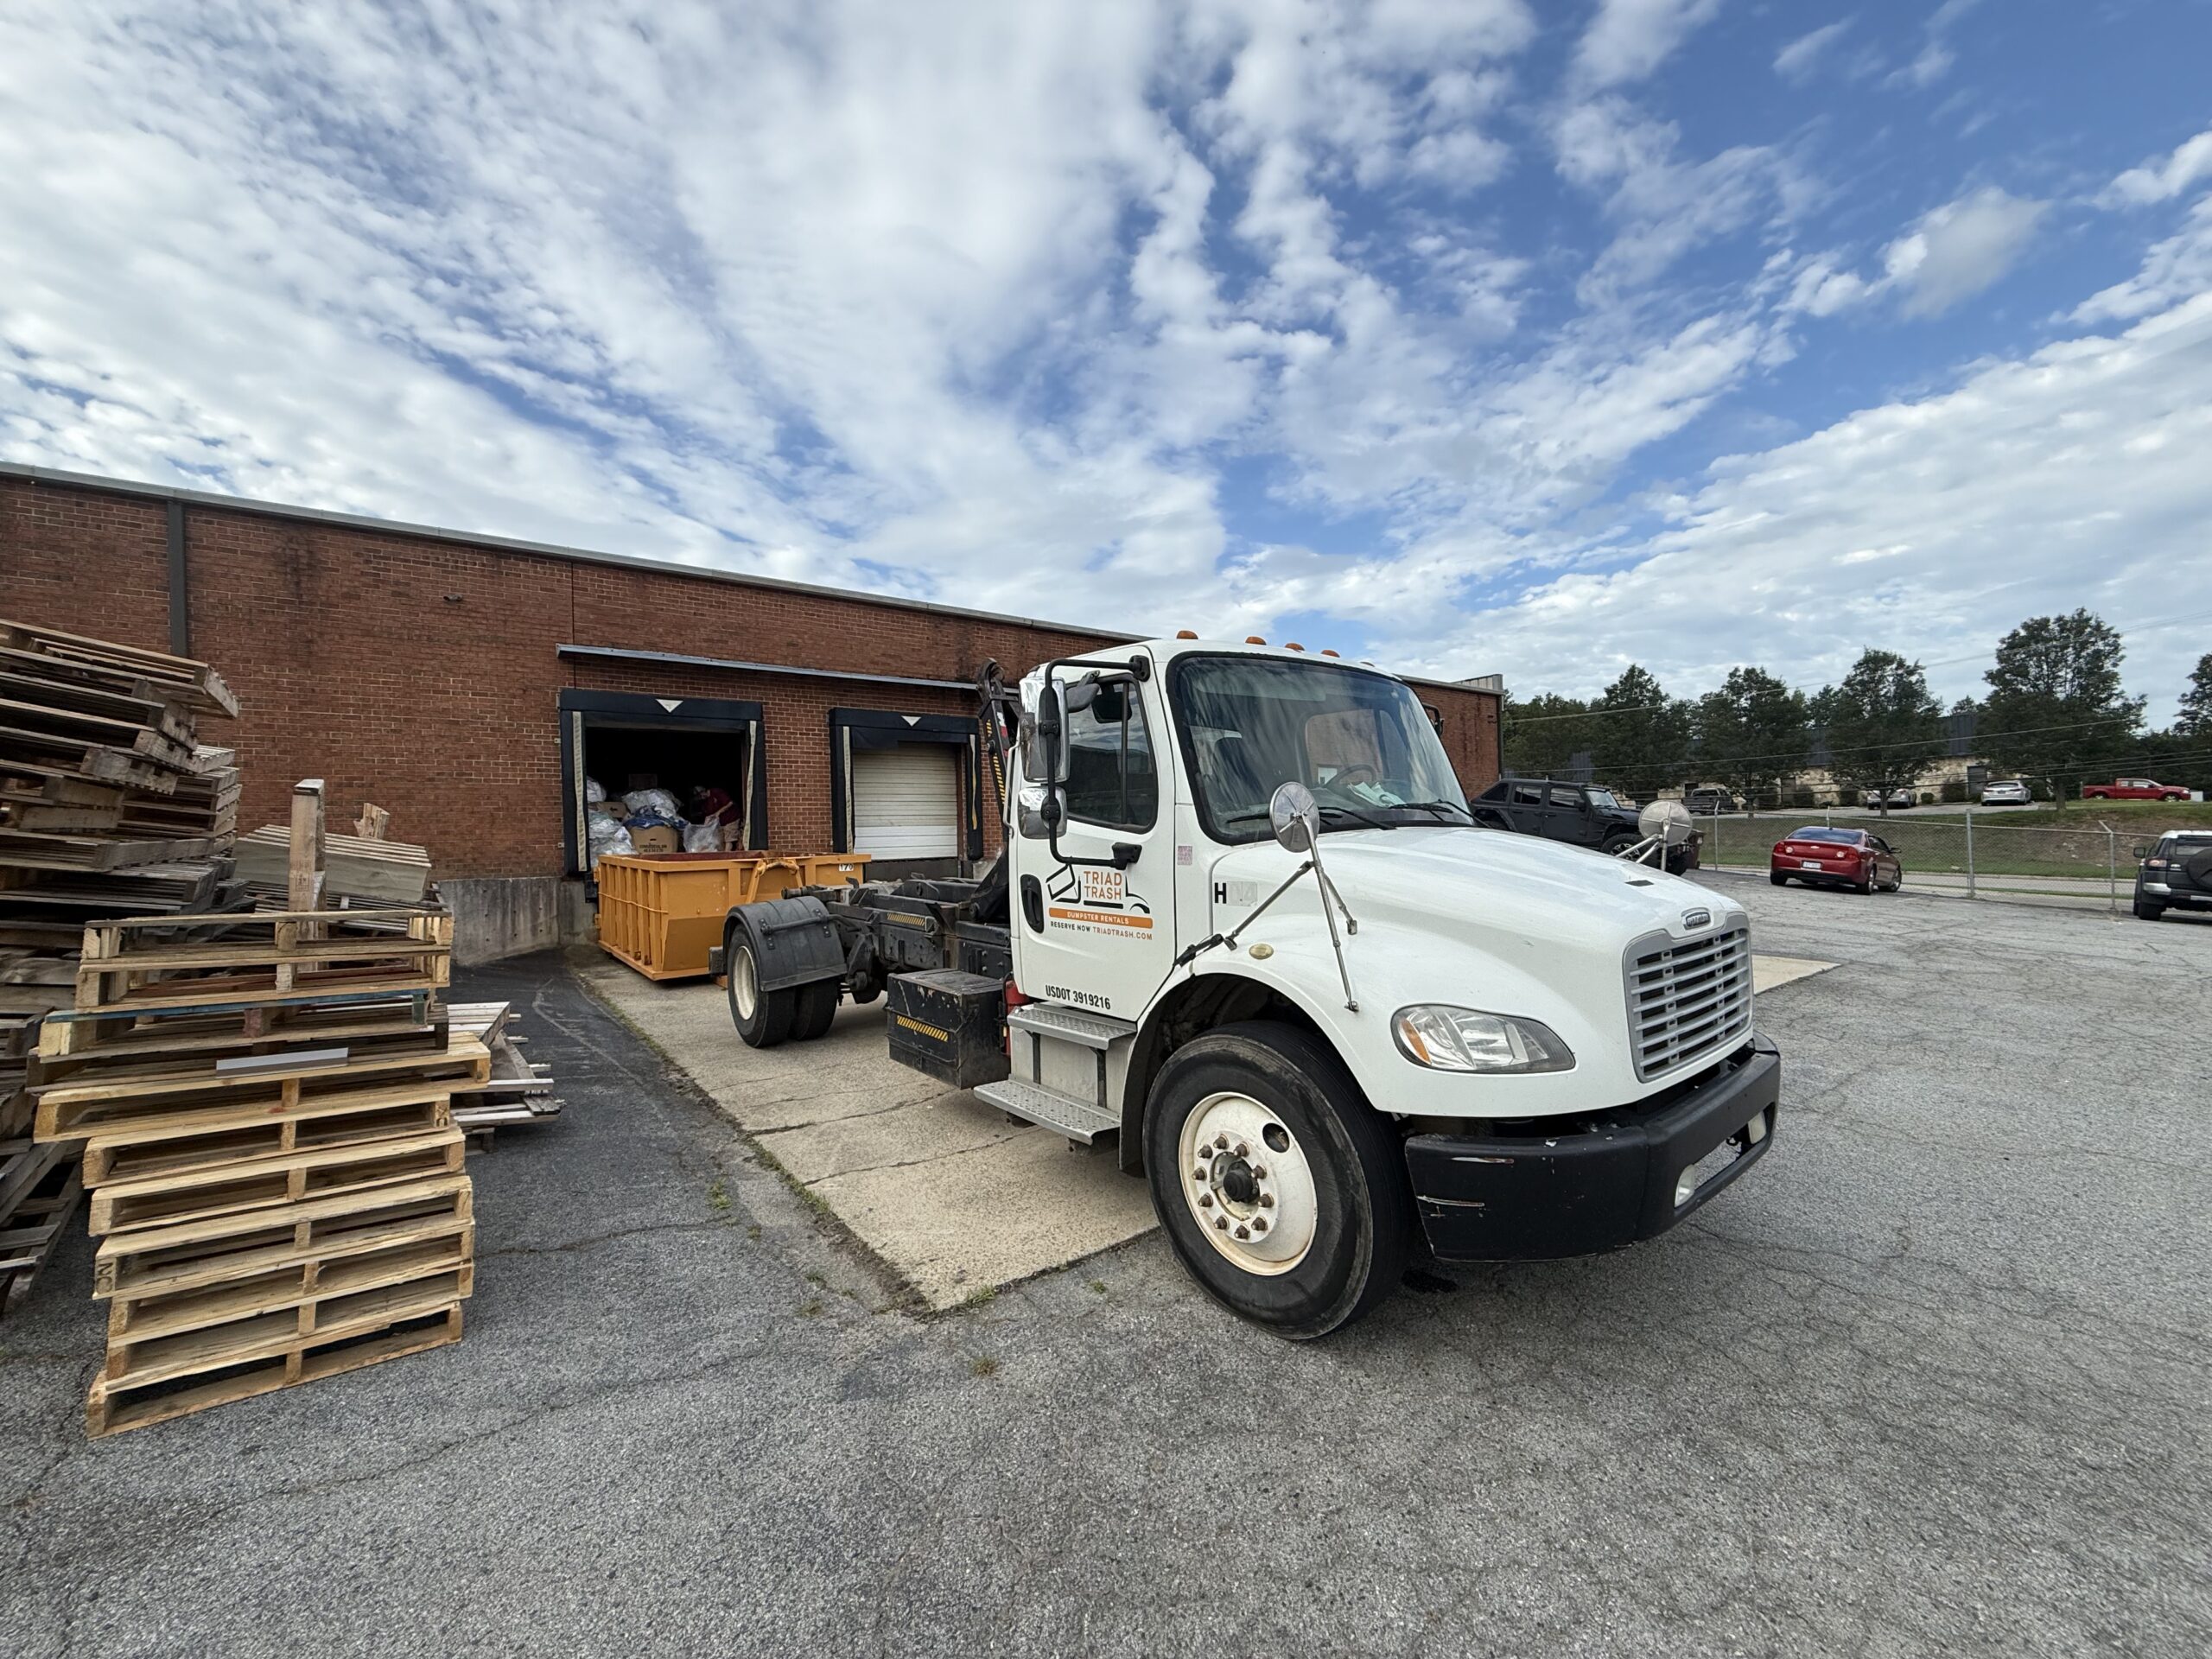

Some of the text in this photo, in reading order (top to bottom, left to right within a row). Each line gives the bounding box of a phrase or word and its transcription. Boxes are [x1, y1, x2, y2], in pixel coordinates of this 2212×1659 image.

[1084, 871, 1122, 886] TRIAD
[1084, 886, 1122, 899] TRASH
[1067, 912, 1129, 925] DUMPSTER RENTALS
[1051, 921, 1153, 940] RESERVE NOW TRIADTRASH.COM
[1046, 984, 1111, 1010] USDOT 3919216
